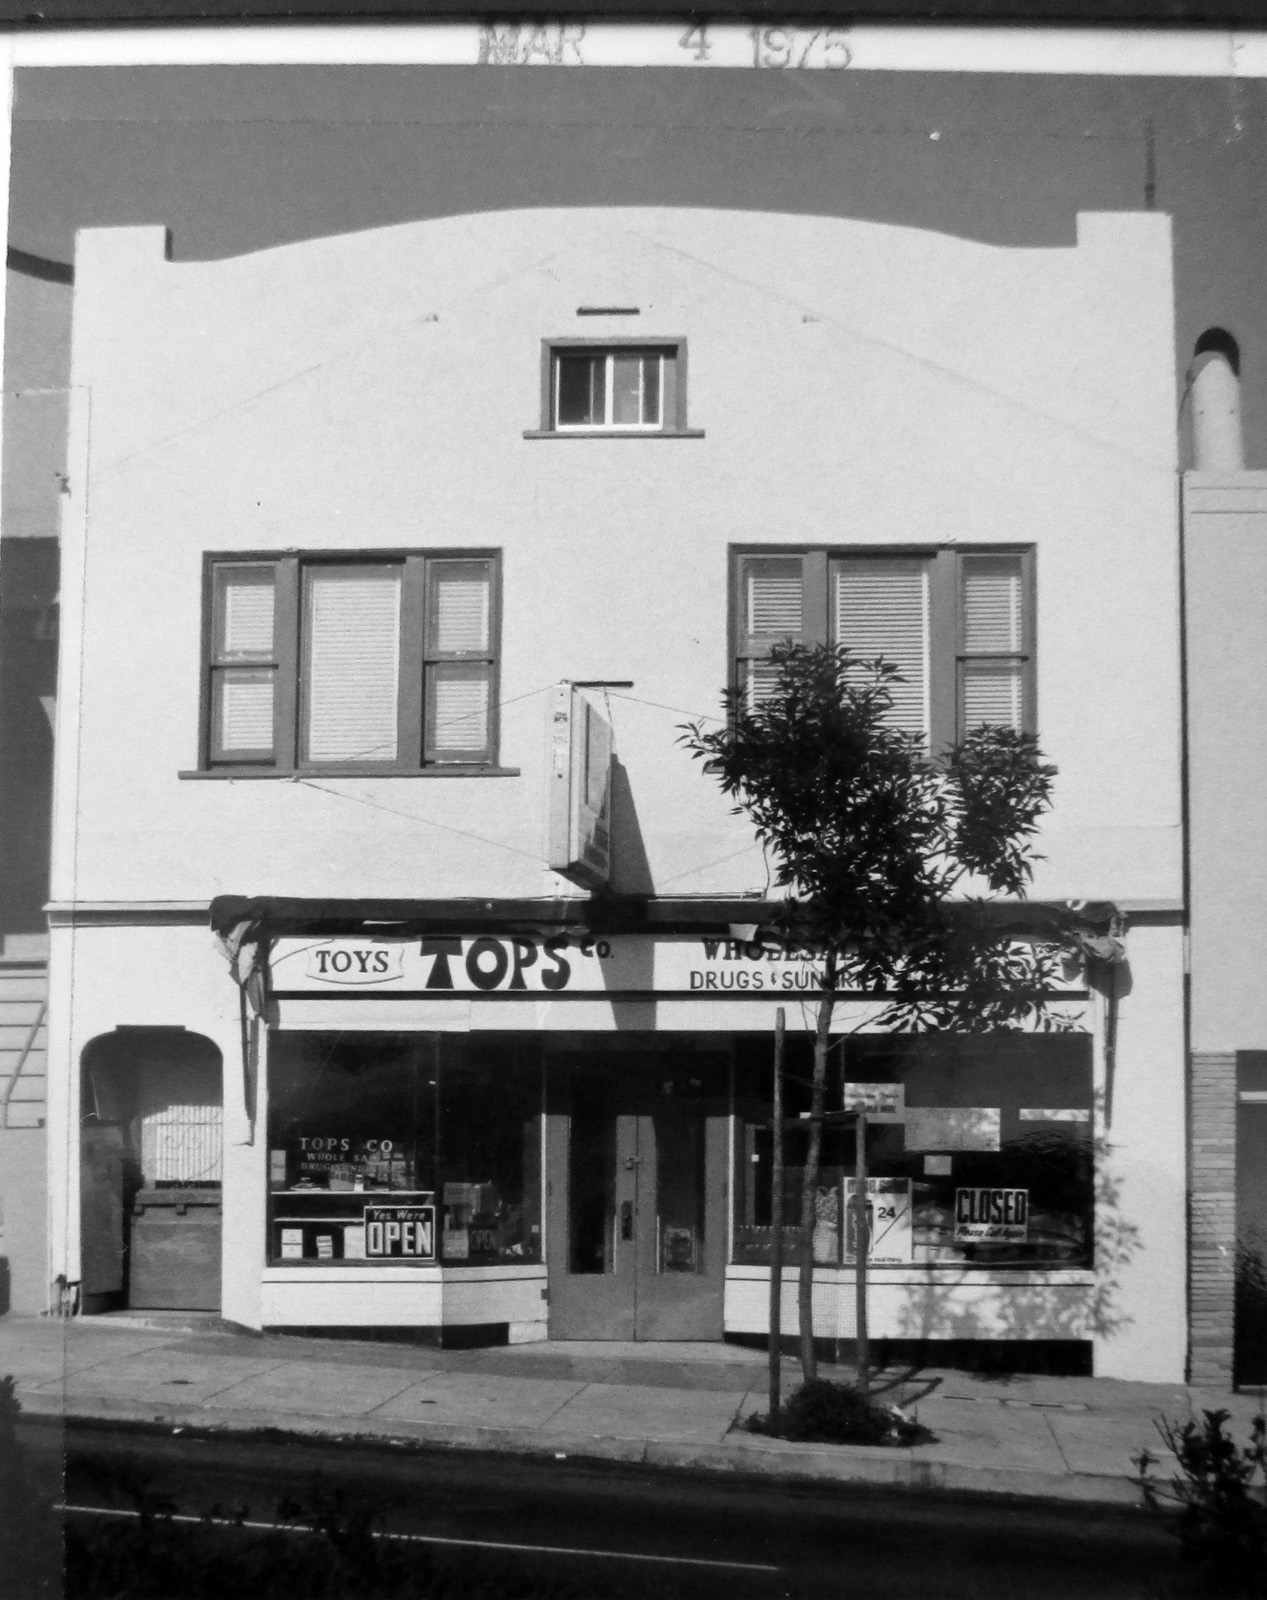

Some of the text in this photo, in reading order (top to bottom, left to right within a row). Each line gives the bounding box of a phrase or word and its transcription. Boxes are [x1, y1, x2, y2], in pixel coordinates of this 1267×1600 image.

[315, 951, 389, 973] TOYS
[420, 936, 572, 990] TOPS
[690, 970, 764, 990] DRUGS
[299, 1137, 350, 1151] TOPS
[877, 1206, 896, 1219] 24
[957, 1190, 1027, 1226] CLOSED
[367, 1221, 432, 1256] OPEN
